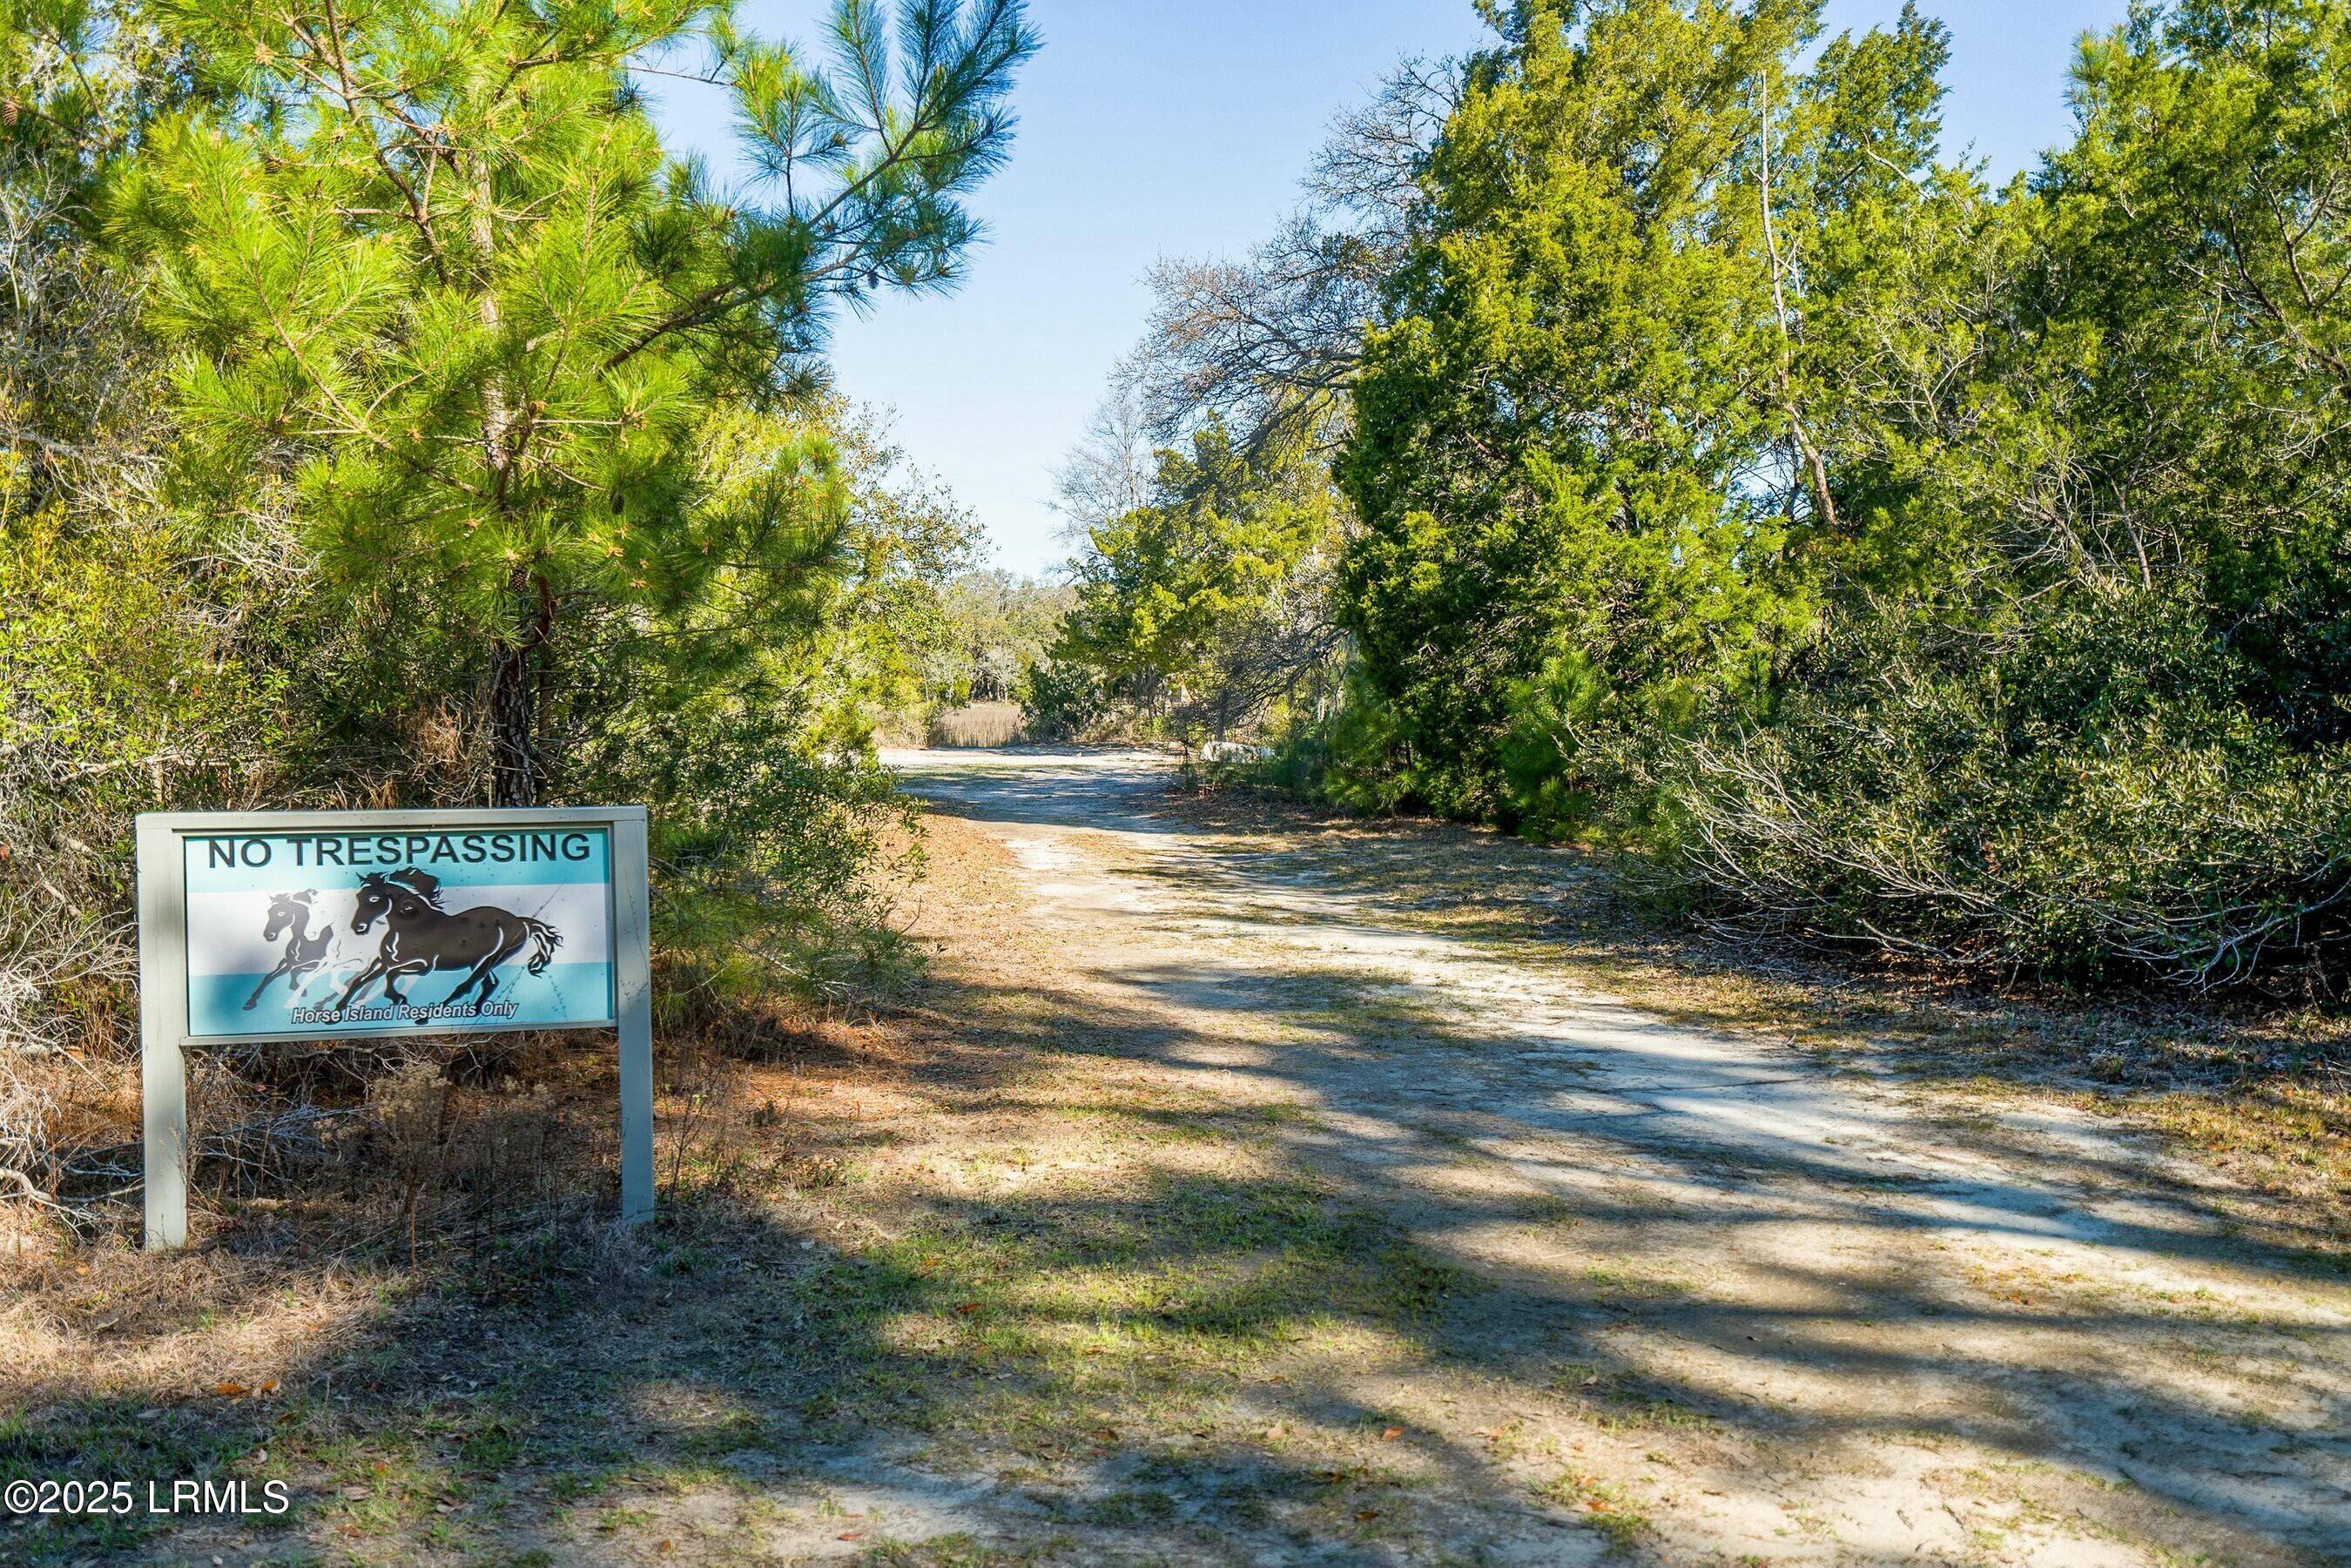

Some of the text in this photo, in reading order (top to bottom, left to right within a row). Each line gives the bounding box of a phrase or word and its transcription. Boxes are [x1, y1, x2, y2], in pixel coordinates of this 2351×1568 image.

[208, 833, 591, 869] NO TRESPASSING
[292, 1000, 519, 1025] Horse Island Residents Only
